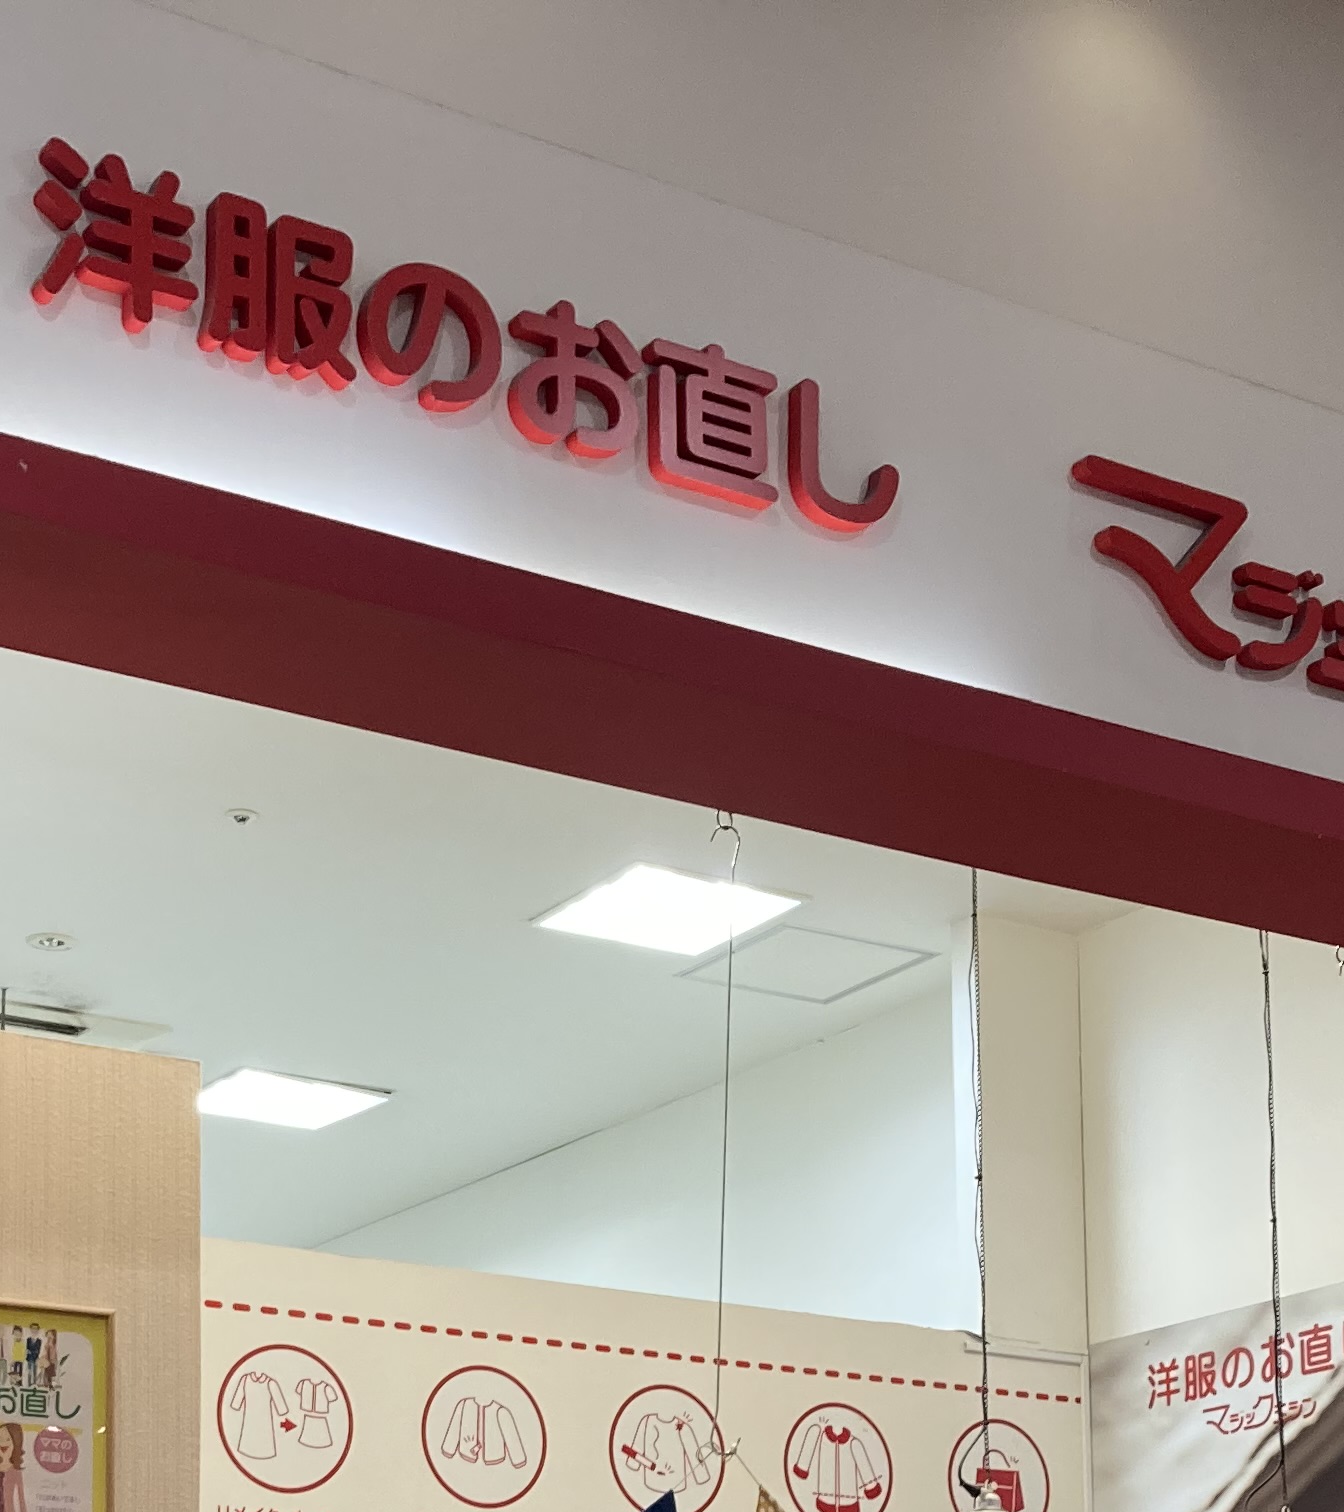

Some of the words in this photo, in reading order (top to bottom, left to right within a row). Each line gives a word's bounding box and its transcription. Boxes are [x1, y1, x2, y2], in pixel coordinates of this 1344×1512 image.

[32, 137, 899, 532] 洋服のお直し
